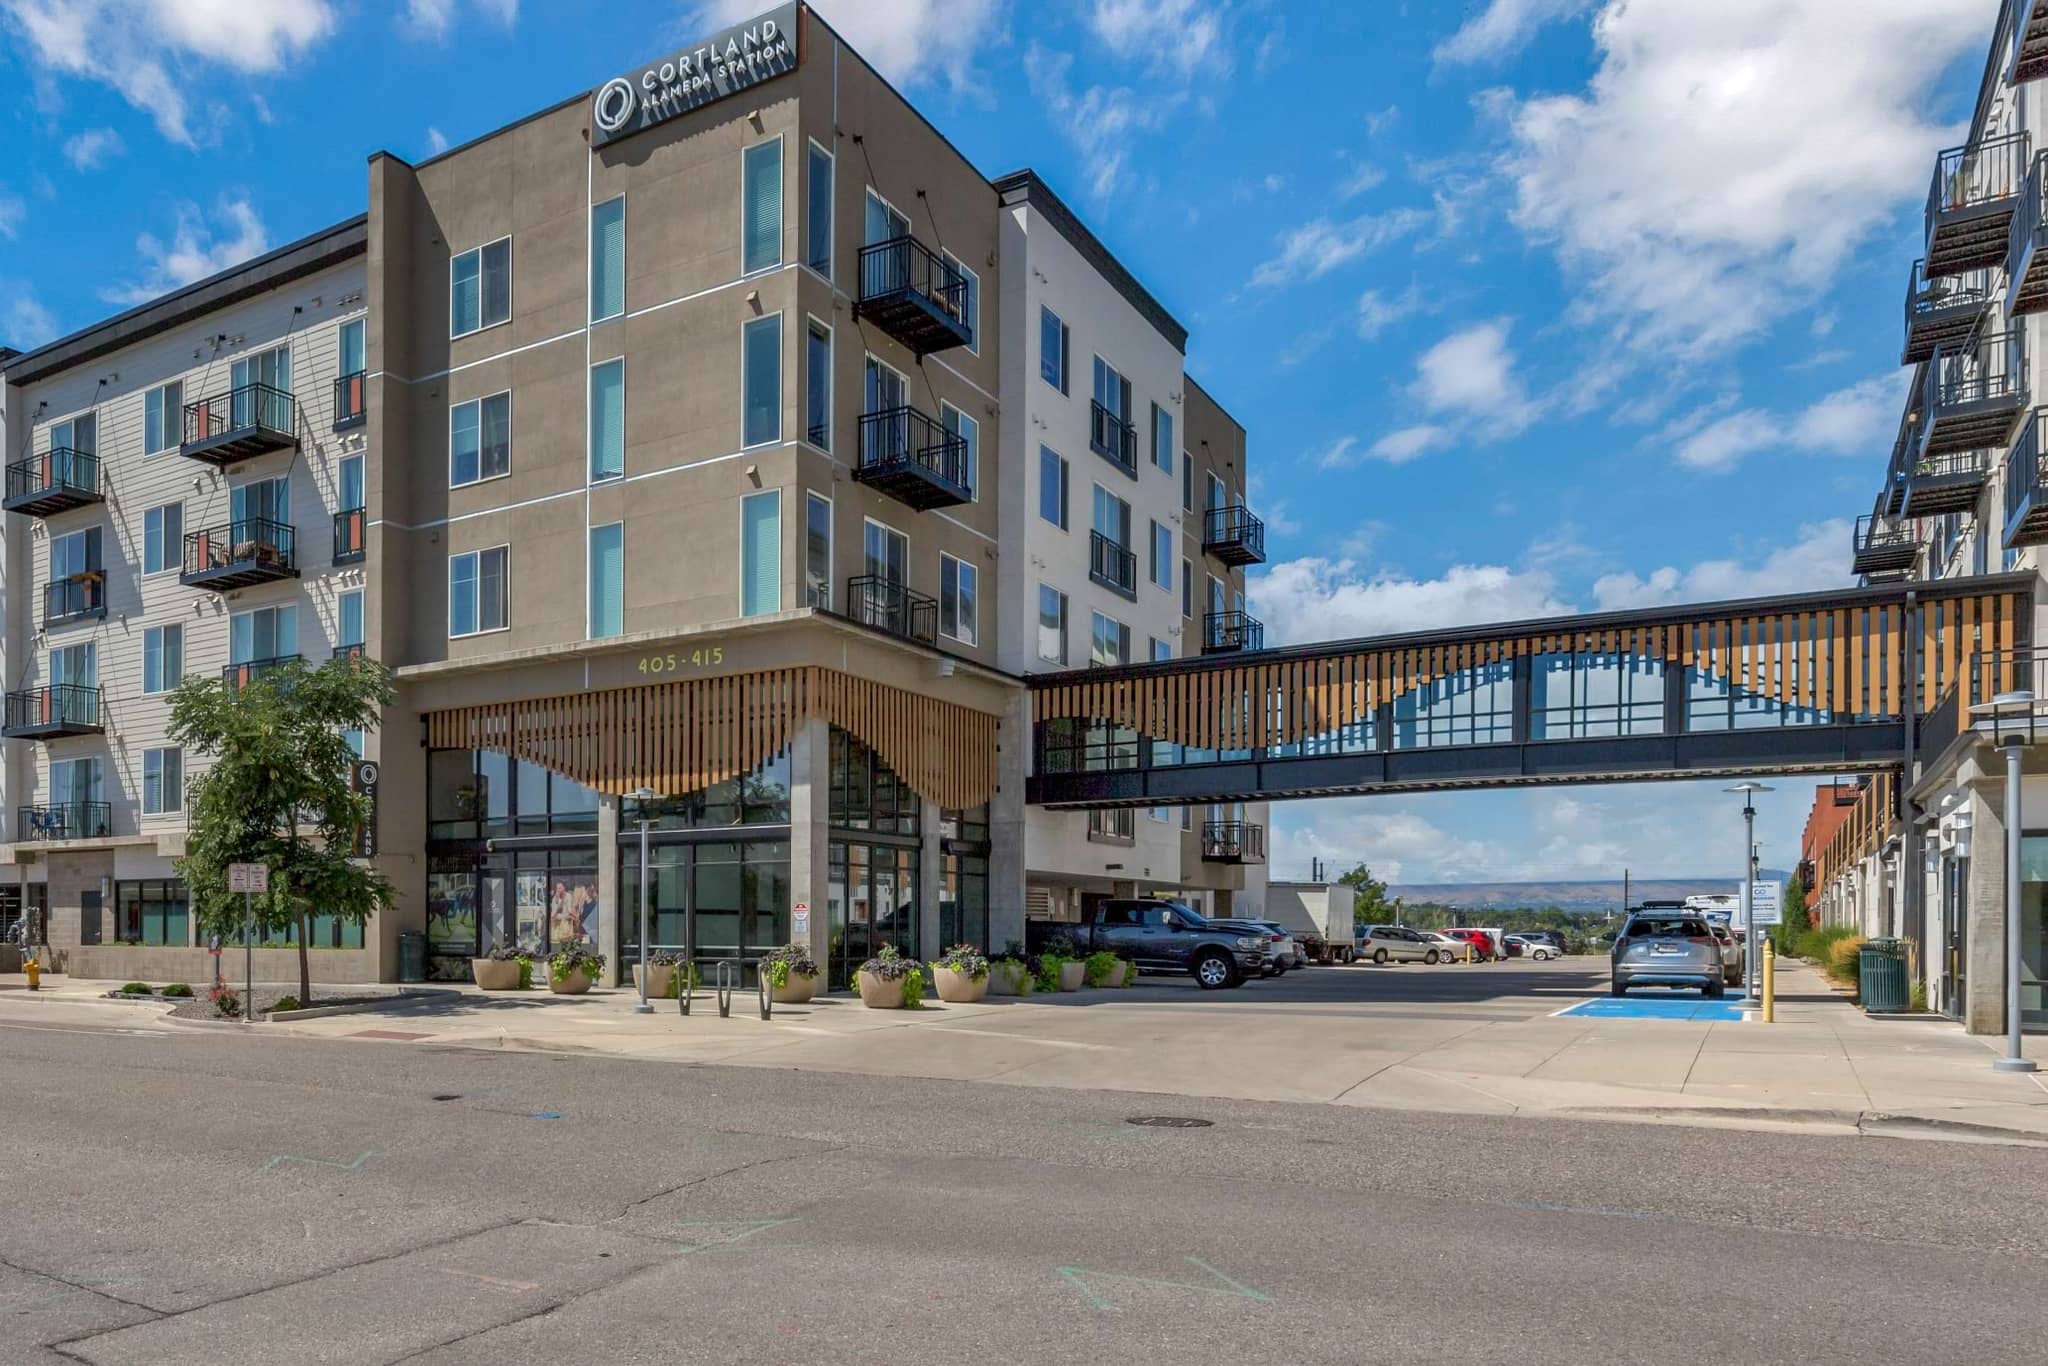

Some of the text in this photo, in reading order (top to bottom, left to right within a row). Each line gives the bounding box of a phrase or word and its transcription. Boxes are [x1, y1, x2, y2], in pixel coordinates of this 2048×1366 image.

[641, 40, 786, 110] ALAMEDA STATION
[642, 20, 777, 89] CORTLAND
